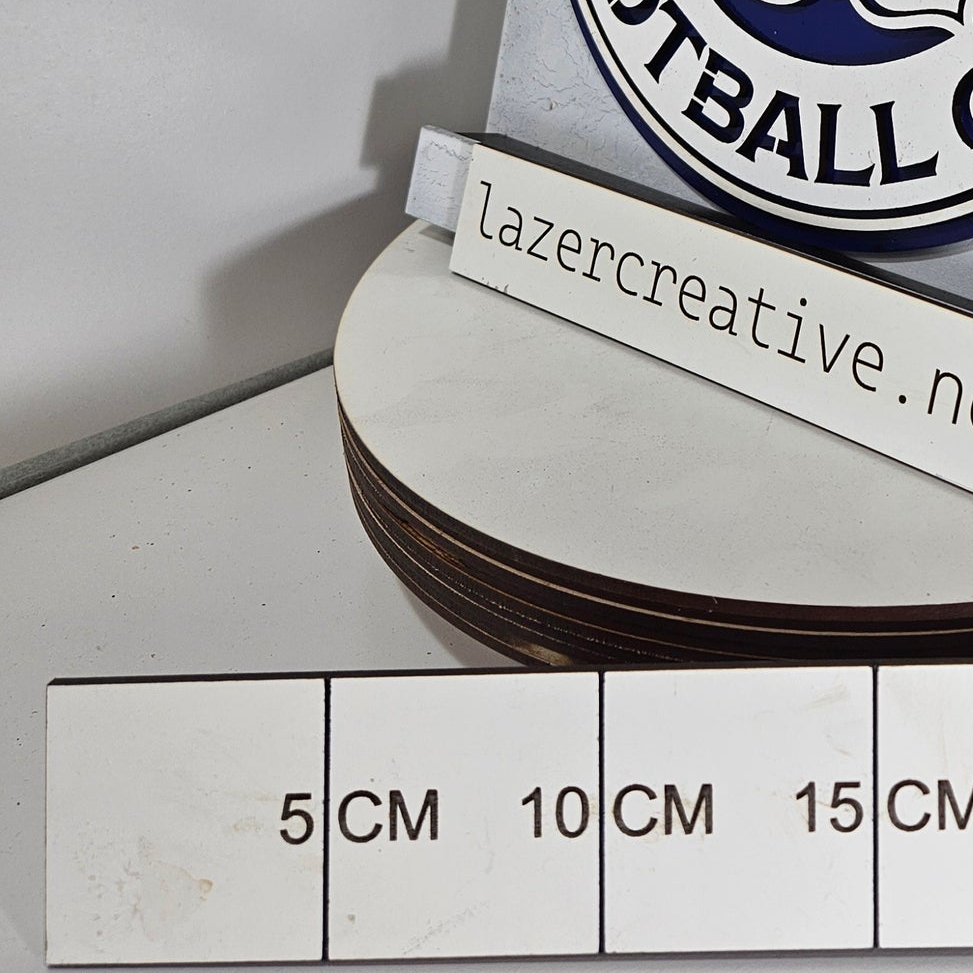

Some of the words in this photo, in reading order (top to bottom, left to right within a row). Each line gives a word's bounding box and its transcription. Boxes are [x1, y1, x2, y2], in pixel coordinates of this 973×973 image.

[279, 793, 313, 845] 5
[338, 789, 440, 841] CM
[520, 786, 590, 839] 10
[612, 783, 715, 837] CM
[797, 781, 863, 834] 15
